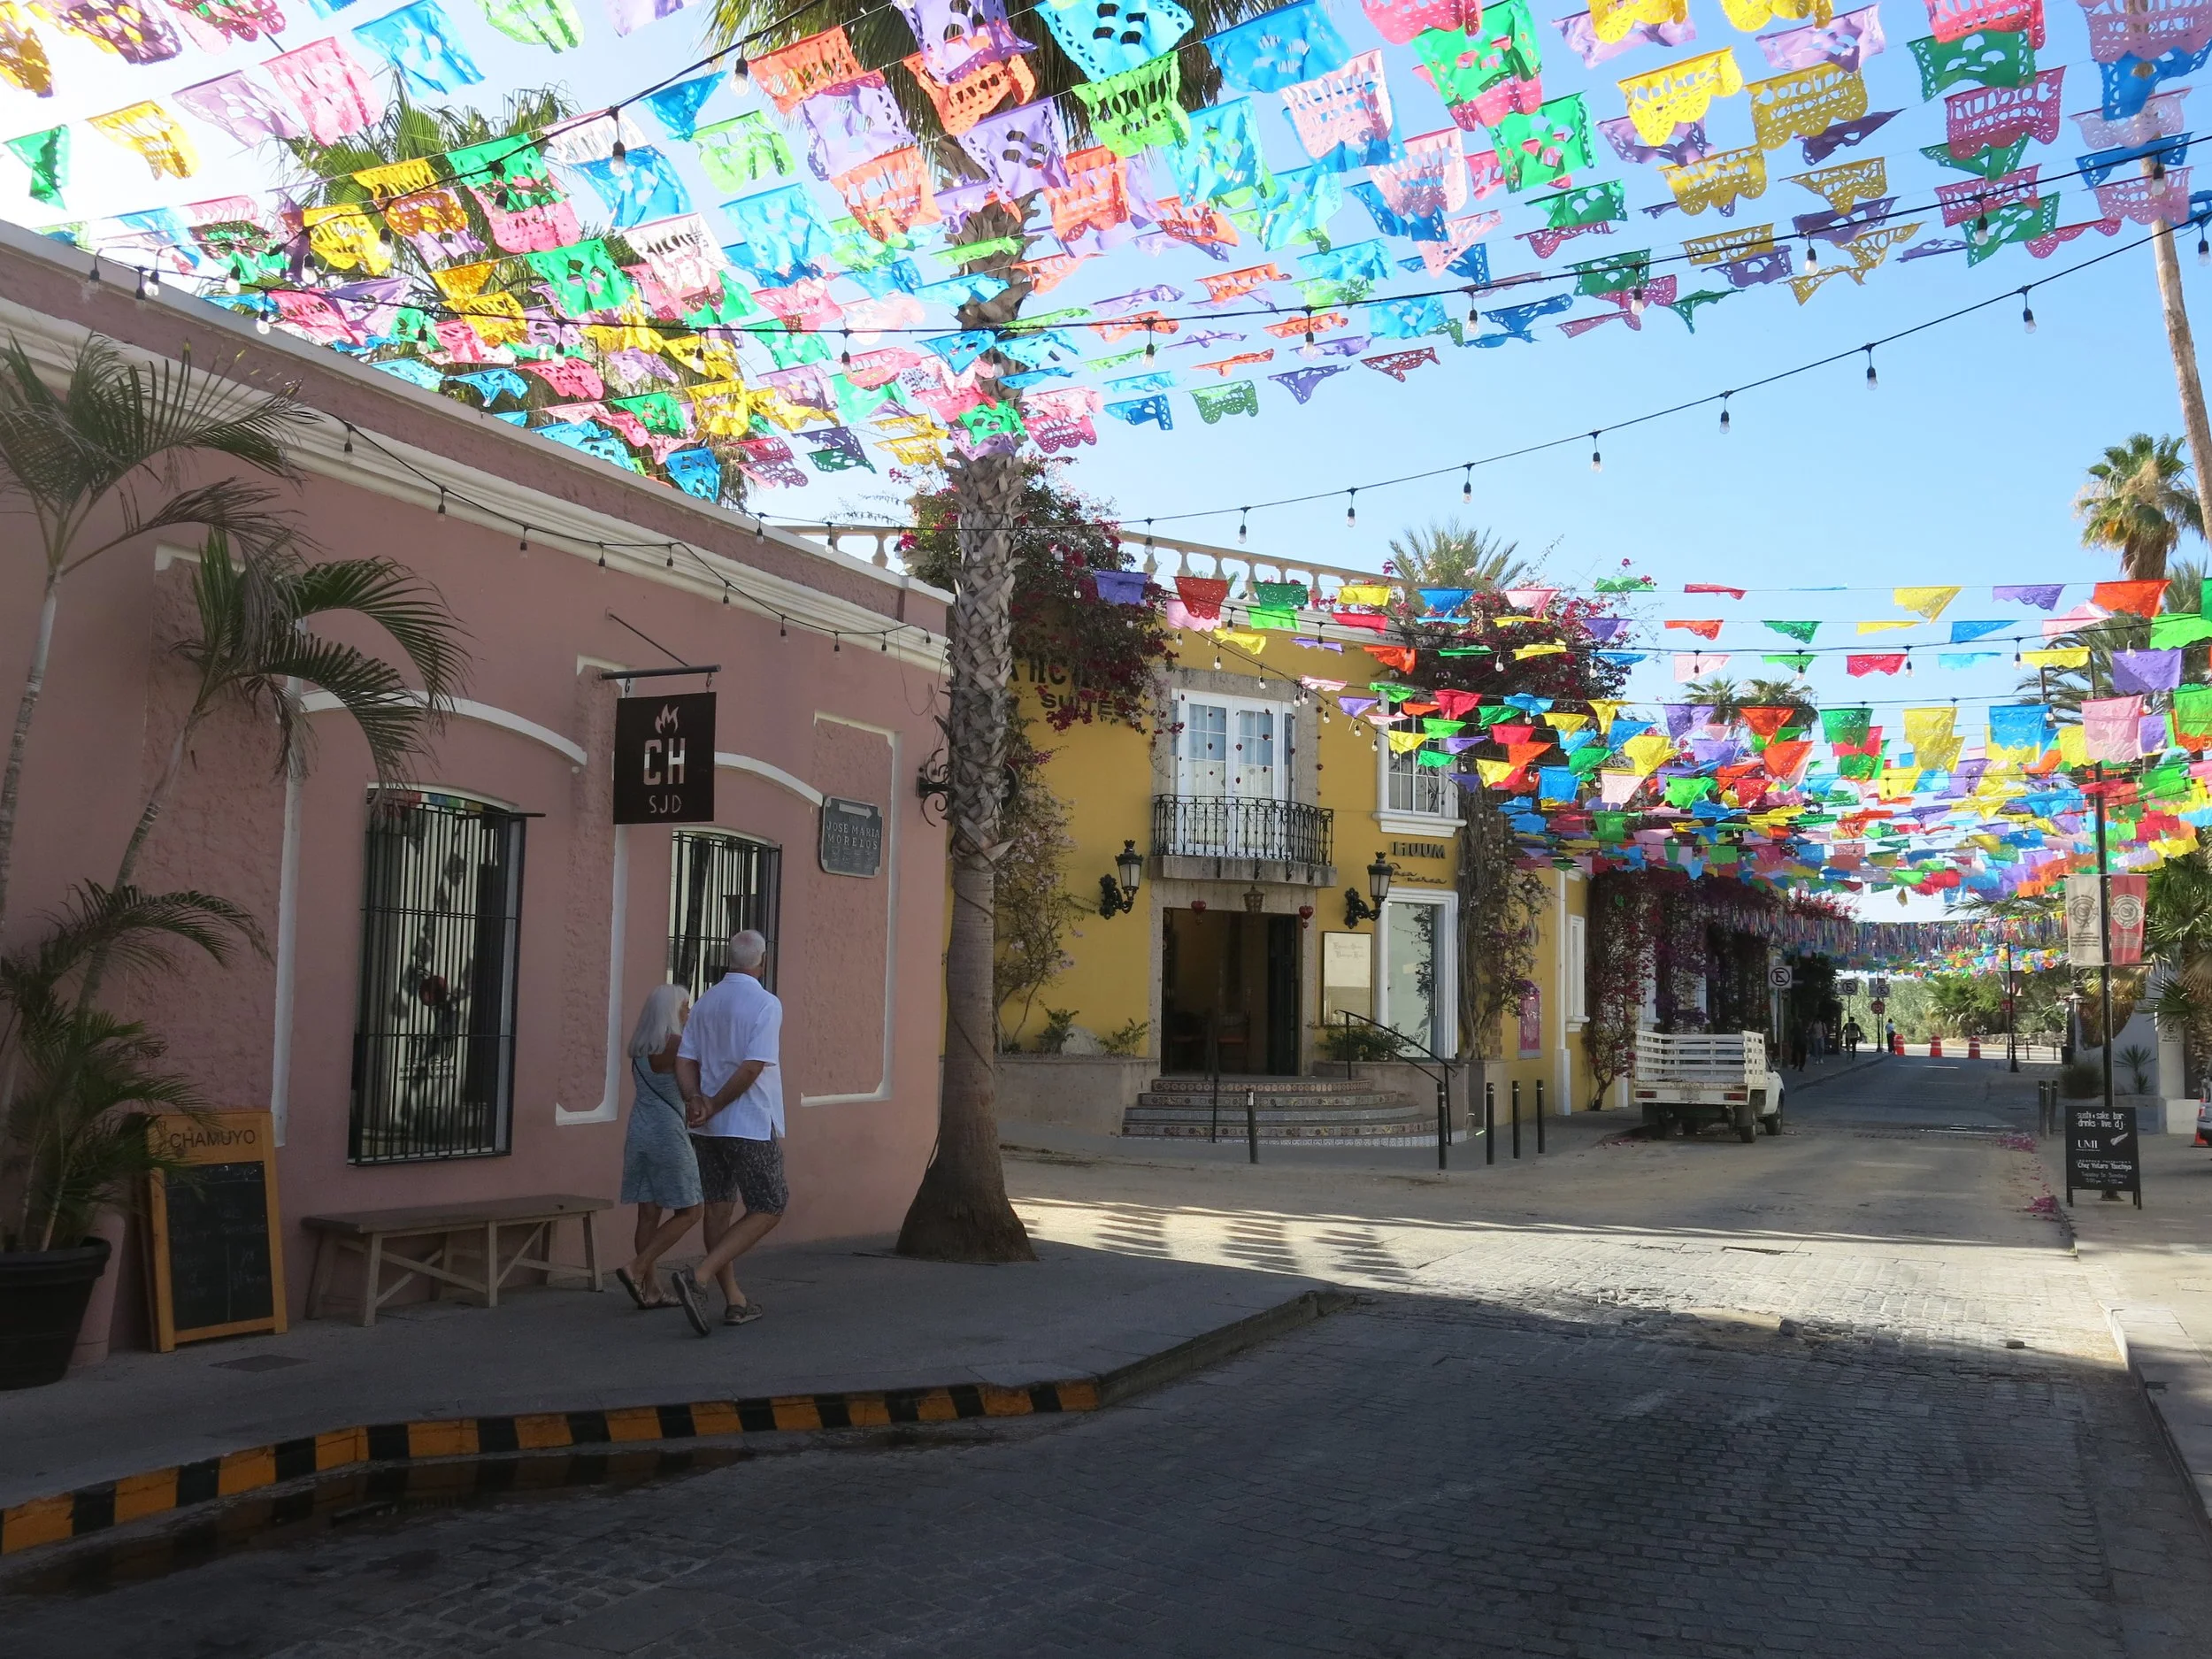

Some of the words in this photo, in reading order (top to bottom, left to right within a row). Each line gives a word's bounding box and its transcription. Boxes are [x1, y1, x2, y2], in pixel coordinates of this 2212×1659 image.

[1041, 693, 1126, 718] SUITE
[643, 737, 686, 786] CH
[649, 795, 682, 815] SJD
[826, 821, 849, 833] JOSE
[851, 825, 880, 839] MARIA
[827, 833, 879, 850] MORELOS
[169, 1129, 256, 1148] CHAMUYO
